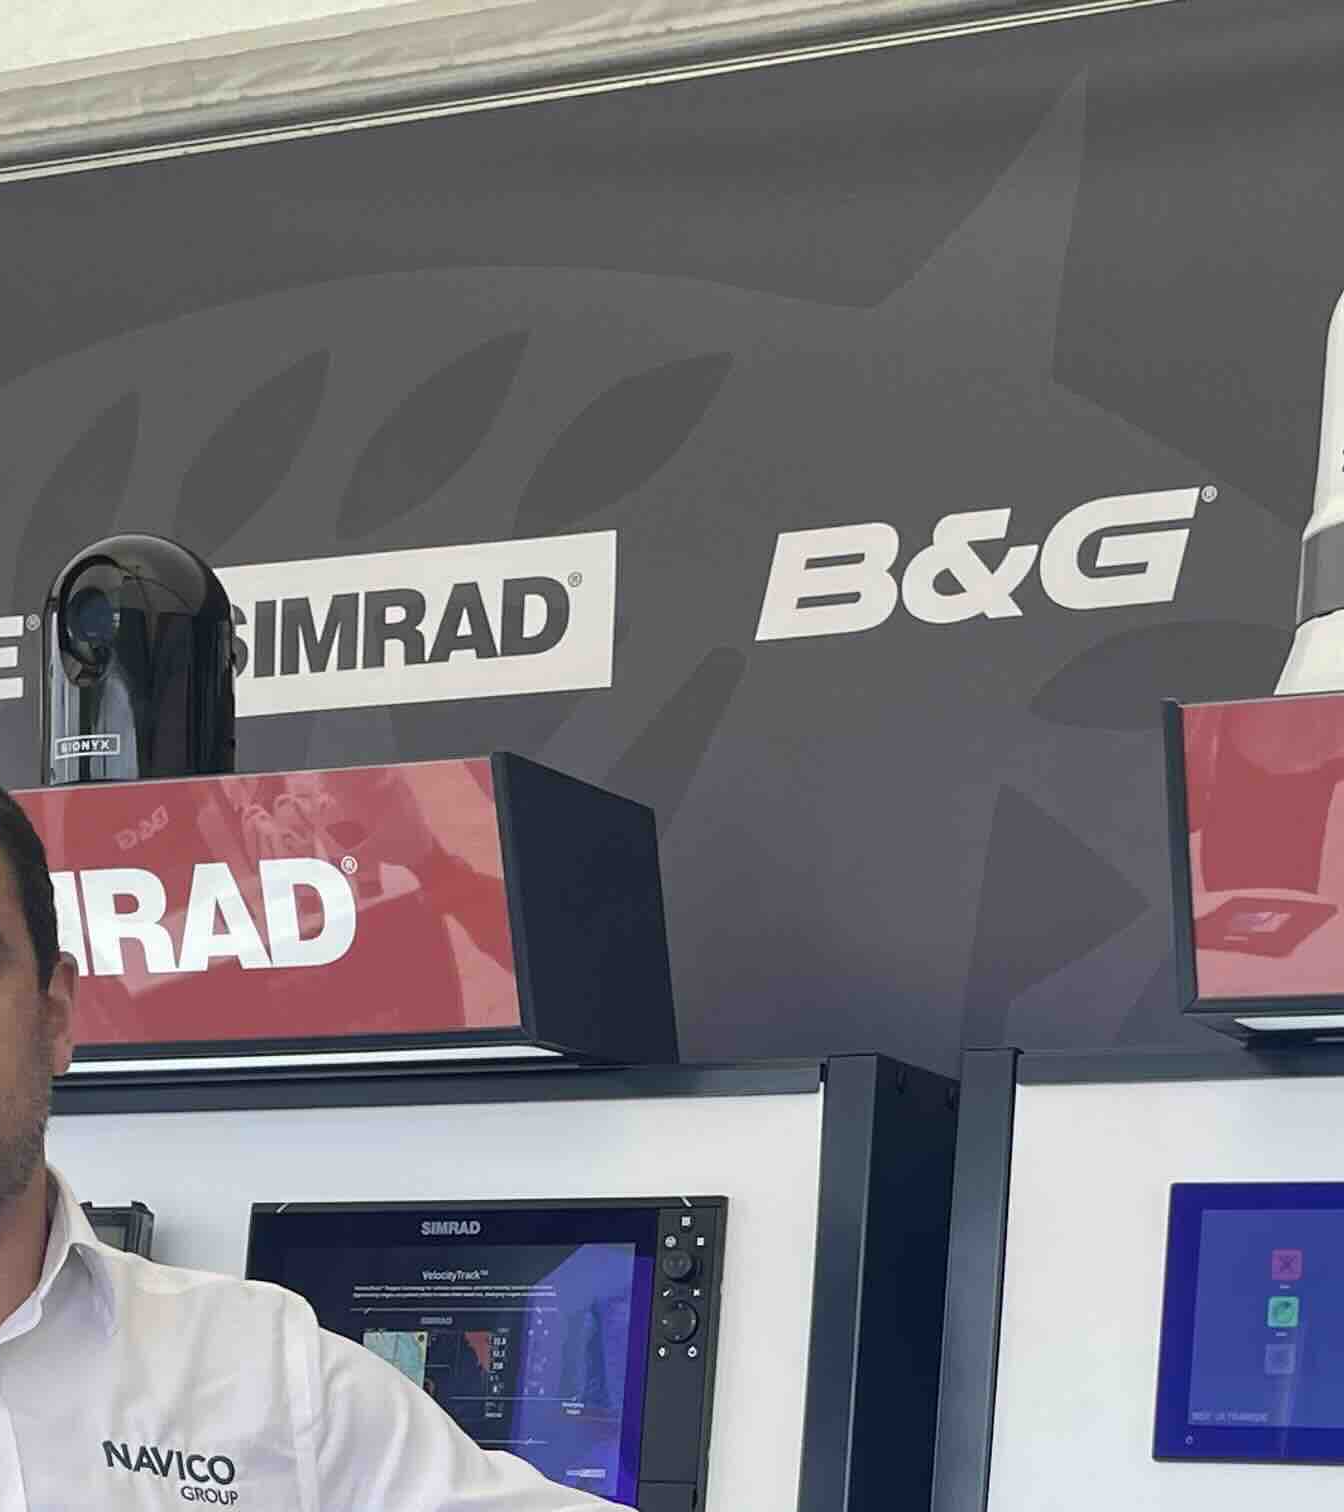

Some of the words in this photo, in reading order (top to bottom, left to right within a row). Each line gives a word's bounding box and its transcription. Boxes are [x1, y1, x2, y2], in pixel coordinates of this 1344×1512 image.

[755, 485, 1201, 641] B&G
[421, 1220, 481, 1236] SIMRAD
[102, 1440, 236, 1485] NAVICO
[180, 1486, 239, 1506] GROUP
